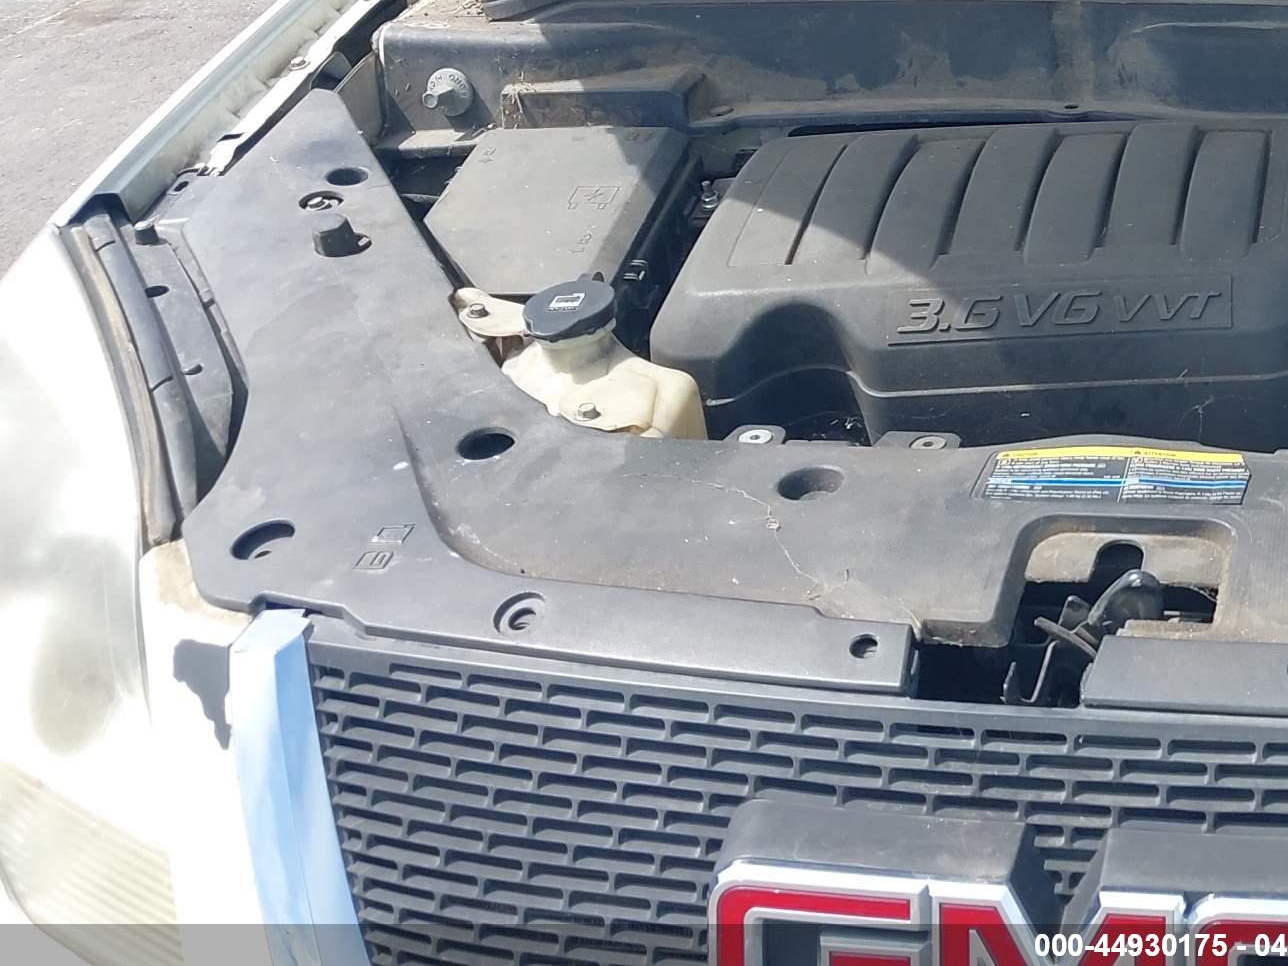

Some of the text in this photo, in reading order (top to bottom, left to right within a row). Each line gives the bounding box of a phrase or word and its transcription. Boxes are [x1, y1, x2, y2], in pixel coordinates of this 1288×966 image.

[897, 291, 1222, 333] 3.6 V6 VVT
